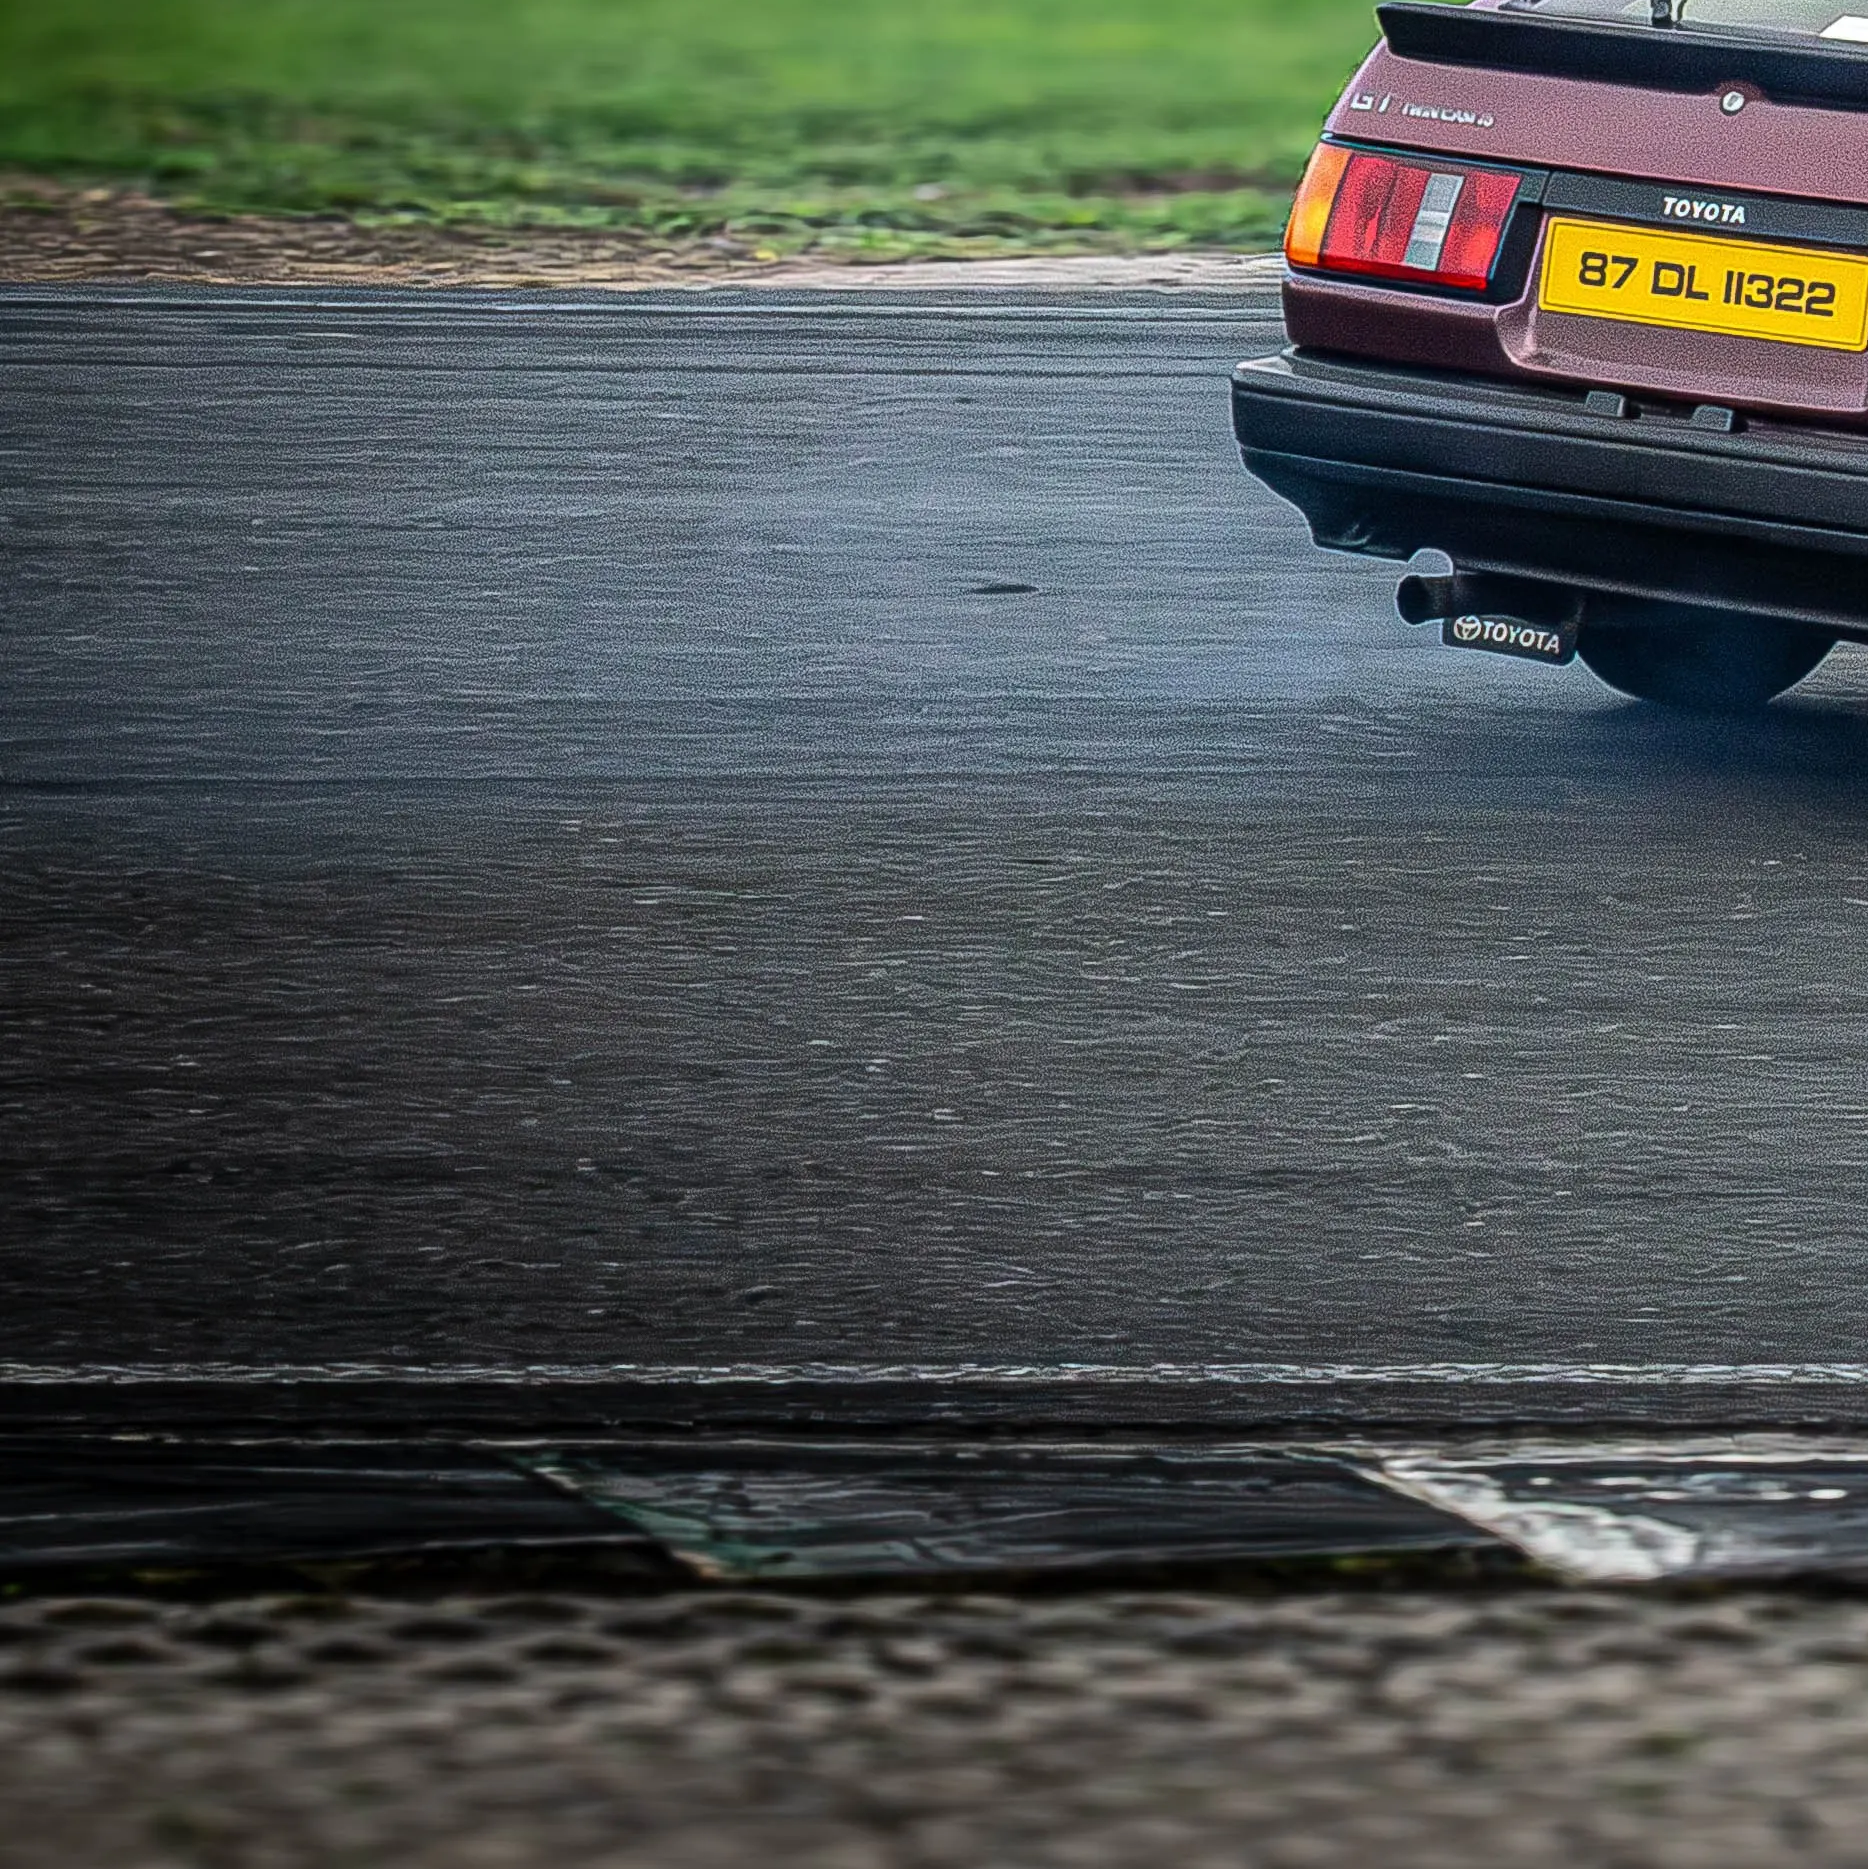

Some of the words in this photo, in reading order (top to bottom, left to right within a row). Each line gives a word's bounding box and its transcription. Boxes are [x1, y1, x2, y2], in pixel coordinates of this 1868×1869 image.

[1663, 196, 1746, 224] TOYOTA
[1578, 251, 1639, 289] 87
[1651, 261, 1709, 304] DL
[1723, 270, 1836, 317] 11322
[1481, 620, 1561, 655] TOYOTA
